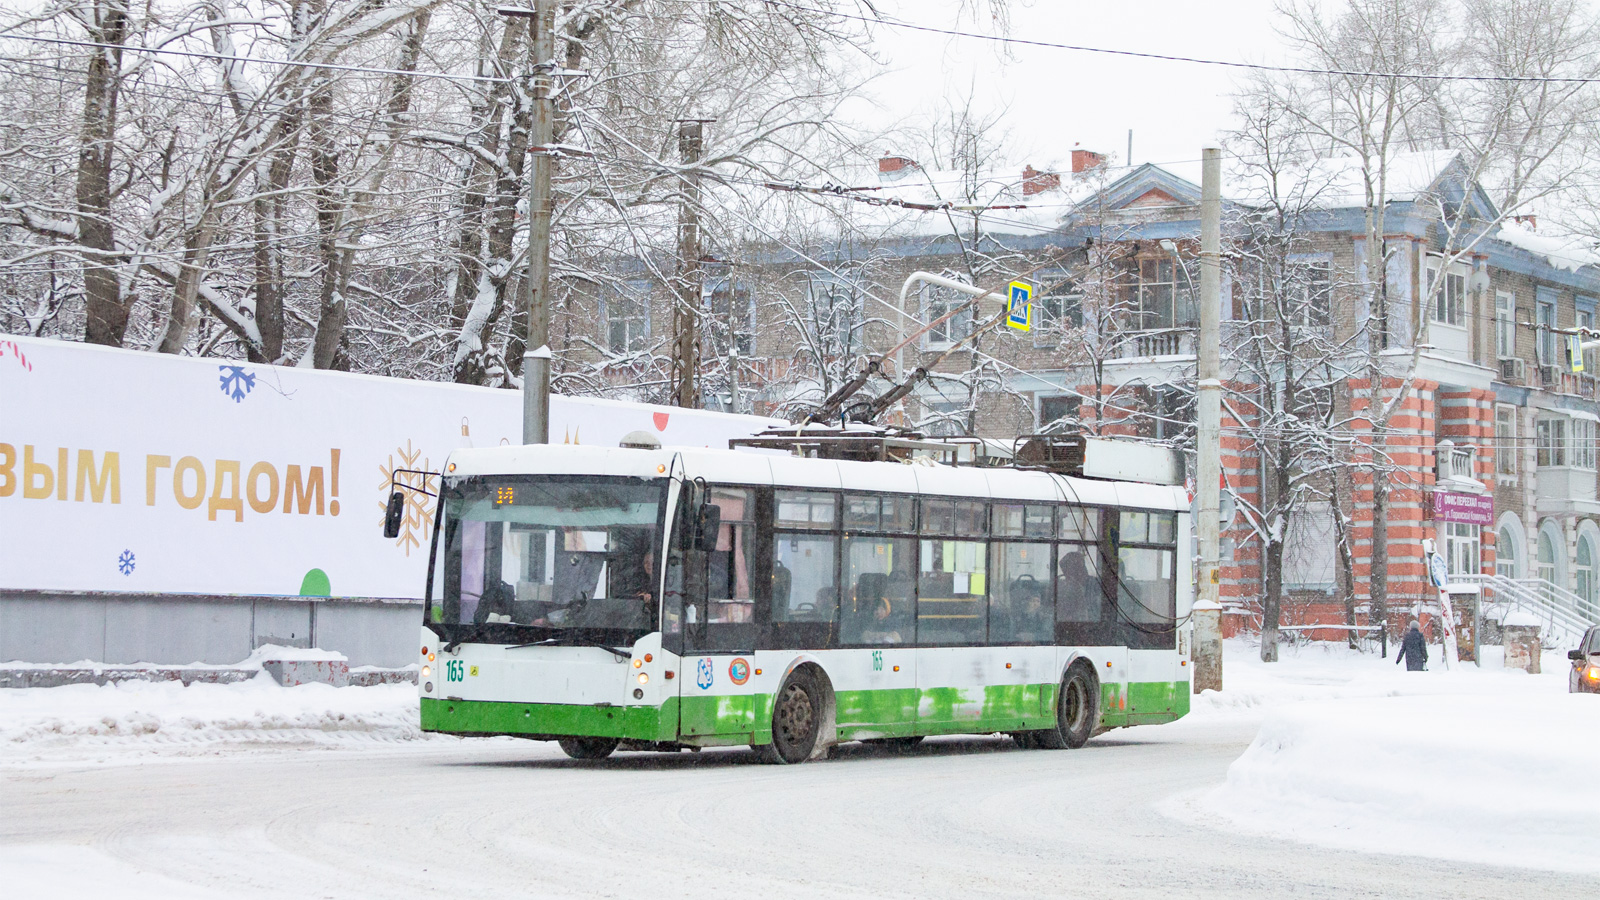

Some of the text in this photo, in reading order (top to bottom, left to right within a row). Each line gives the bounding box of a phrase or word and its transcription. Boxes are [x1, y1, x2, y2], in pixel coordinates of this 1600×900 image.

[145, 447, 341, 523] ГОДОМ!
[496, 487, 513, 504] 14
[1444, 495, 1456, 505] ОФИС
[1457, 496, 1477, 507] ПЕРЕЕХАЛ
[446, 660, 464, 682] 165
[872, 650, 883, 671] 165
